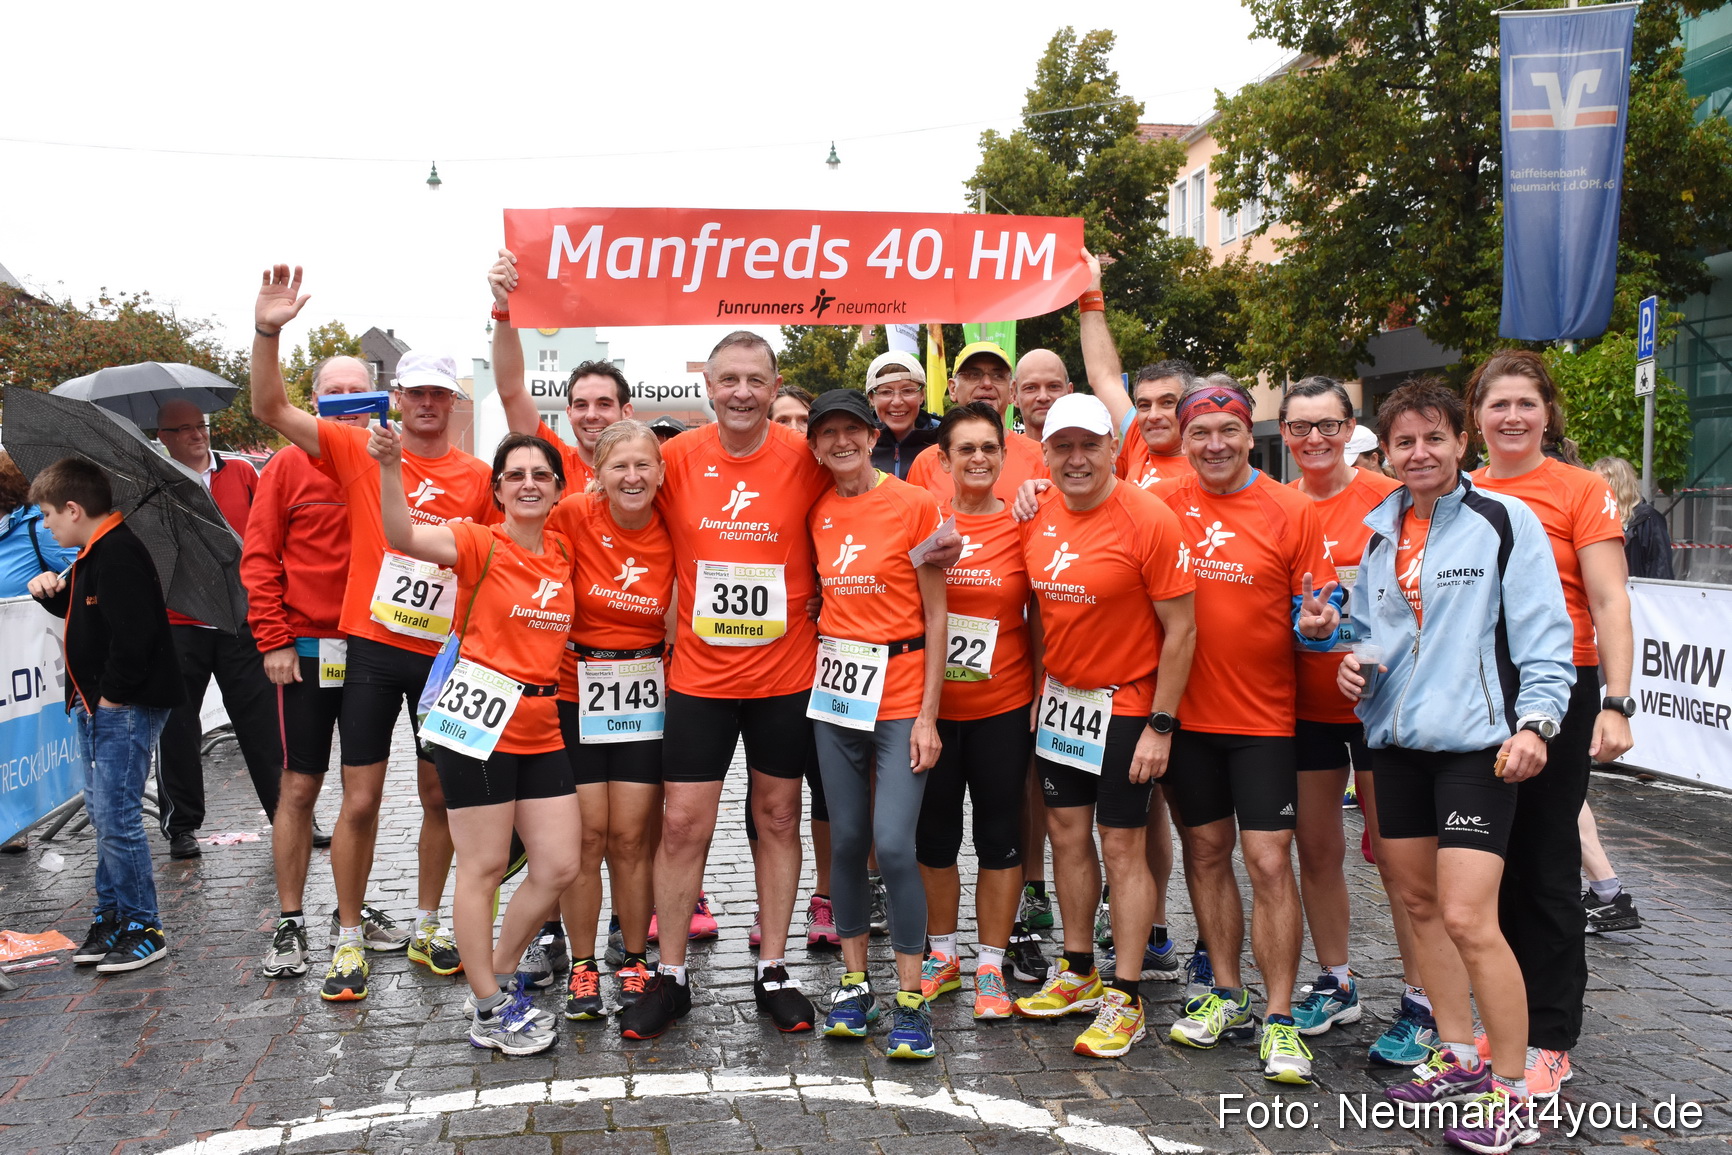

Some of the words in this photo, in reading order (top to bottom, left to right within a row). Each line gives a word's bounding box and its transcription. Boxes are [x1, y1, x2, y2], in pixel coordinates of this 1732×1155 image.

[1510, 166, 1587, 179] Raiffeisenbank
[1510, 182, 1561, 193] Neumarkt
[547, 222, 850, 293] Manfreds
[866, 228, 954, 280] 40.
[968, 230, 1056, 281] HM
[717, 300, 804, 317] funrunners
[836, 300, 907, 314] neumarkt
[1641, 306, 1651, 352] P
[531, 379, 568, 397] BM
[630, 381, 701, 402] ufsport
[699, 517, 770, 531] funrunners
[719, 530, 778, 543] neumarkt
[420, 564, 453, 580] BOCK
[703, 570, 730, 578] NeuerMarkt
[734, 566, 777, 578] BOCK
[1191, 557, 1244, 573] nrunners
[820, 575, 876, 588] unrunners
[944, 576, 1002, 587] eumarkt
[1193, 568, 1254, 585] neumarkt
[1436, 568, 1485, 580] SIEMENS
[834, 583, 887, 596] neumarkt
[1031, 577, 1086, 594] funrunners
[1436, 580, 1461, 588] SIMATIC
[391, 575, 444, 611] 297
[588, 584, 658, 606] funrunners
[712, 583, 769, 617] 330
[1044, 590, 1096, 604] neumarkt
[509, 605, 571, 622] funrunners
[607, 600, 665, 615] neumarkt
[393, 610, 430, 629] Harald
[527, 619, 572, 633] neumarkt
[948, 616, 990, 632] BOCK
[714, 622, 764, 636] Manfred
[840, 642, 882, 658] BOCK
[948, 636, 987, 668] 22
[618, 662, 657, 675] BOCK
[1642, 638, 1726, 688] BMW
[326, 667, 346, 678] Har
[821, 656, 878, 696] 2287
[945, 670, 967, 678] OLA
[471, 667, 516, 695] BOCK
[588, 679, 659, 712] 2143
[1067, 686, 1106, 703] BOCK
[437, 678, 507, 729] 2330
[832, 698, 850, 714] Gabi
[1641, 688, 1732, 731] WENIGER
[607, 719, 642, 732] Conny
[1044, 696, 1102, 740] 2144
[439, 719, 467, 740] Stilla
[1051, 736, 1085, 758] Roland
[1445, 811, 1490, 826] live
